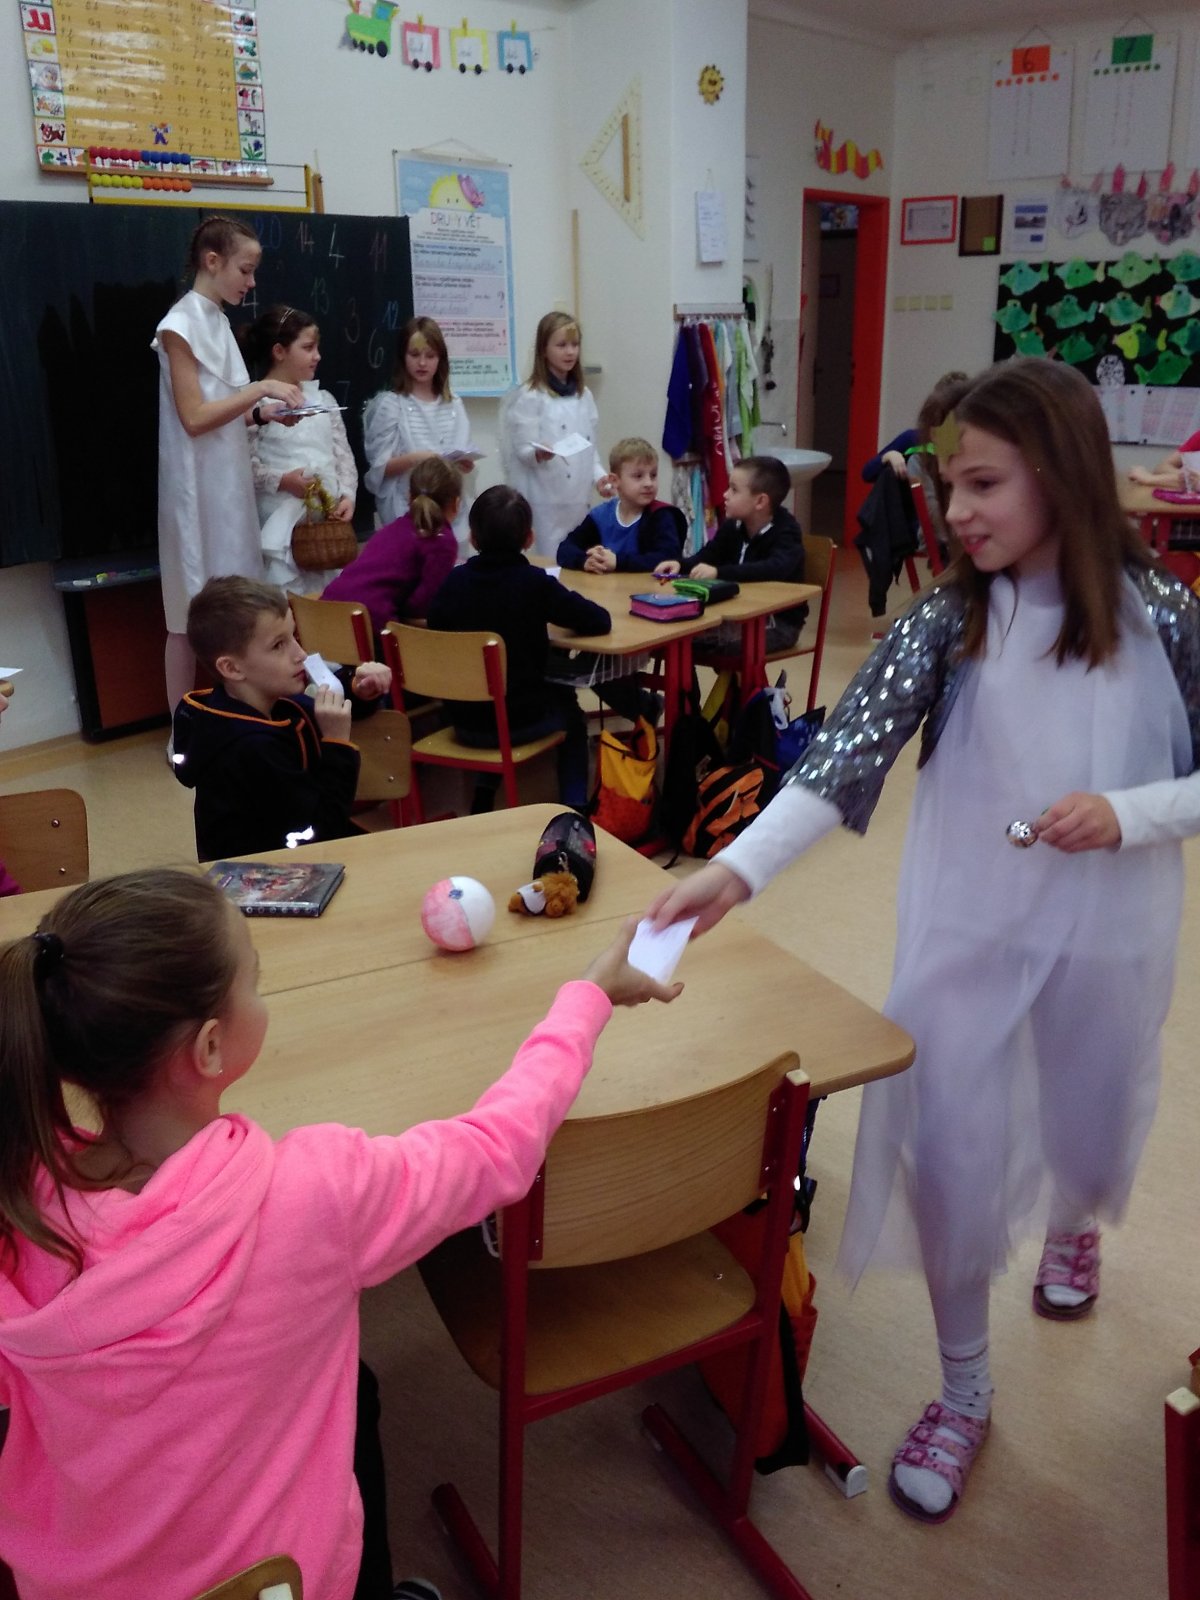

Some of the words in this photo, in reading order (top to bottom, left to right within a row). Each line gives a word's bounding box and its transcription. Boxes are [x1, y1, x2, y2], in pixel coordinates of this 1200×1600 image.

[1023, 46, 1034, 73] 6
[1123, 36, 1137, 64] 7
[296, 221, 316, 256] 14
[328, 222, 345, 269] 4
[369, 231, 388, 273] 11
[310, 277, 330, 315] 13
[344, 296, 361, 344] 3
[382, 300, 402, 331] 12
[368, 327, 384, 369] 6
